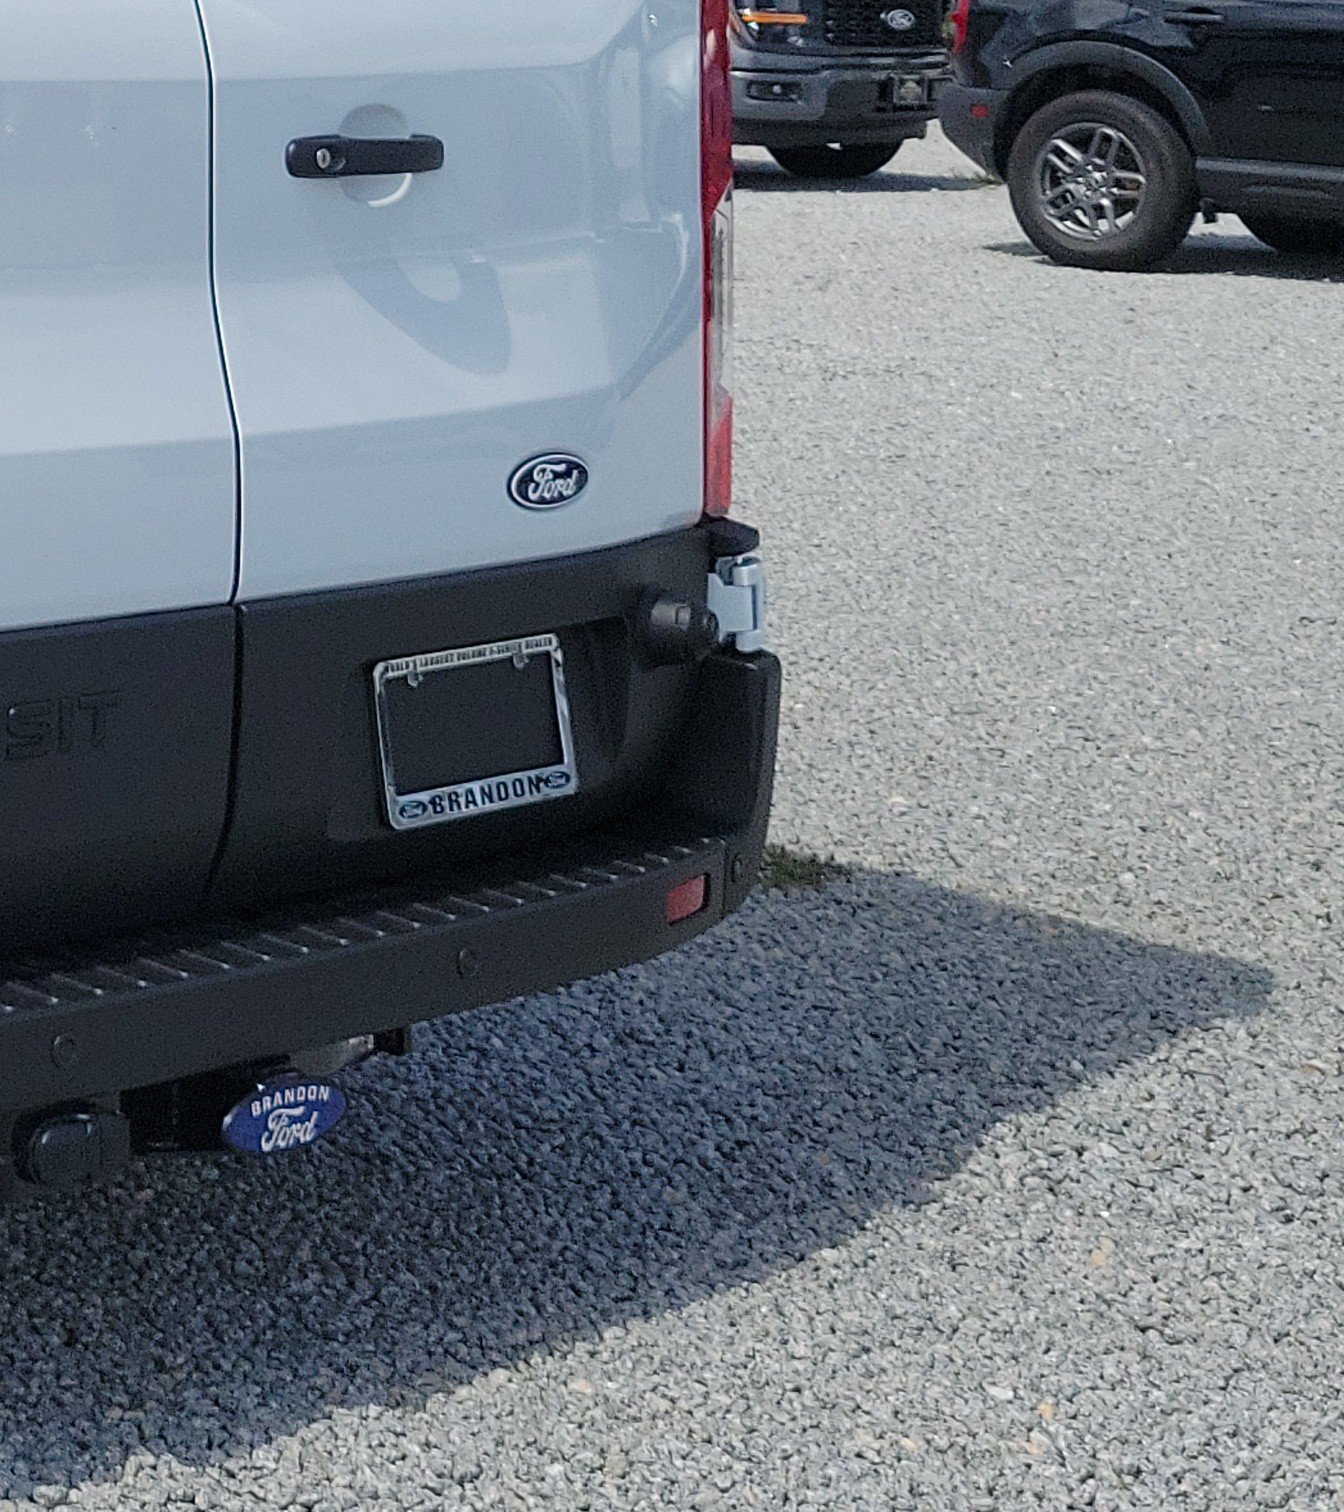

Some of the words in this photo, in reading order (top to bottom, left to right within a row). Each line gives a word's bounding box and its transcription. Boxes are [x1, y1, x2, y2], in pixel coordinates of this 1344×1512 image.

[528, 463, 578, 500] Ford
[430, 775, 543, 816] BRANDON
[251, 1085, 330, 1118] BRANDON
[260, 1105, 319, 1153] Ford
